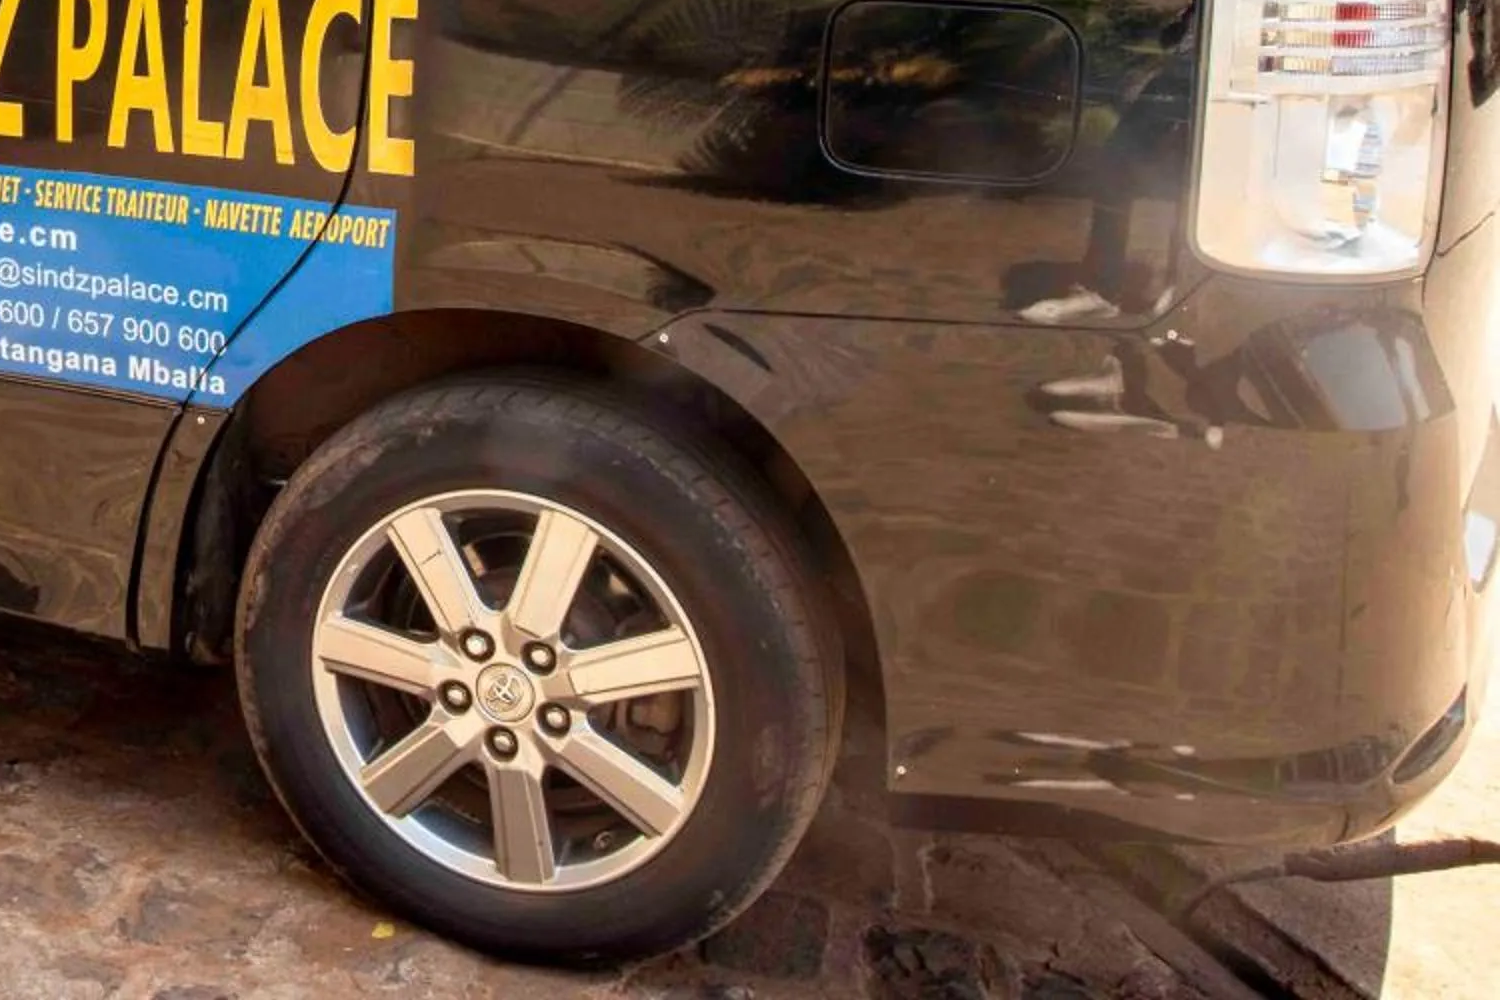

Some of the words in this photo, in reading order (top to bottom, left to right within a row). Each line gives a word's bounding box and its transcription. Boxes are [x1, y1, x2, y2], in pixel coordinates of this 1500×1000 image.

[34, 179, 102, 214] SERVICE
[107, 187, 189, 225] TRAITEUR
[204, 198, 283, 236] NAVETTE
[289, 209, 390, 249] AEROPORT
[0, 299, 44, 328] 600
[67, 309, 115, 338] 657
[123, 317, 170, 347] 900
[178, 325, 228, 358] 600
[128, 355, 226, 396] Mballa
